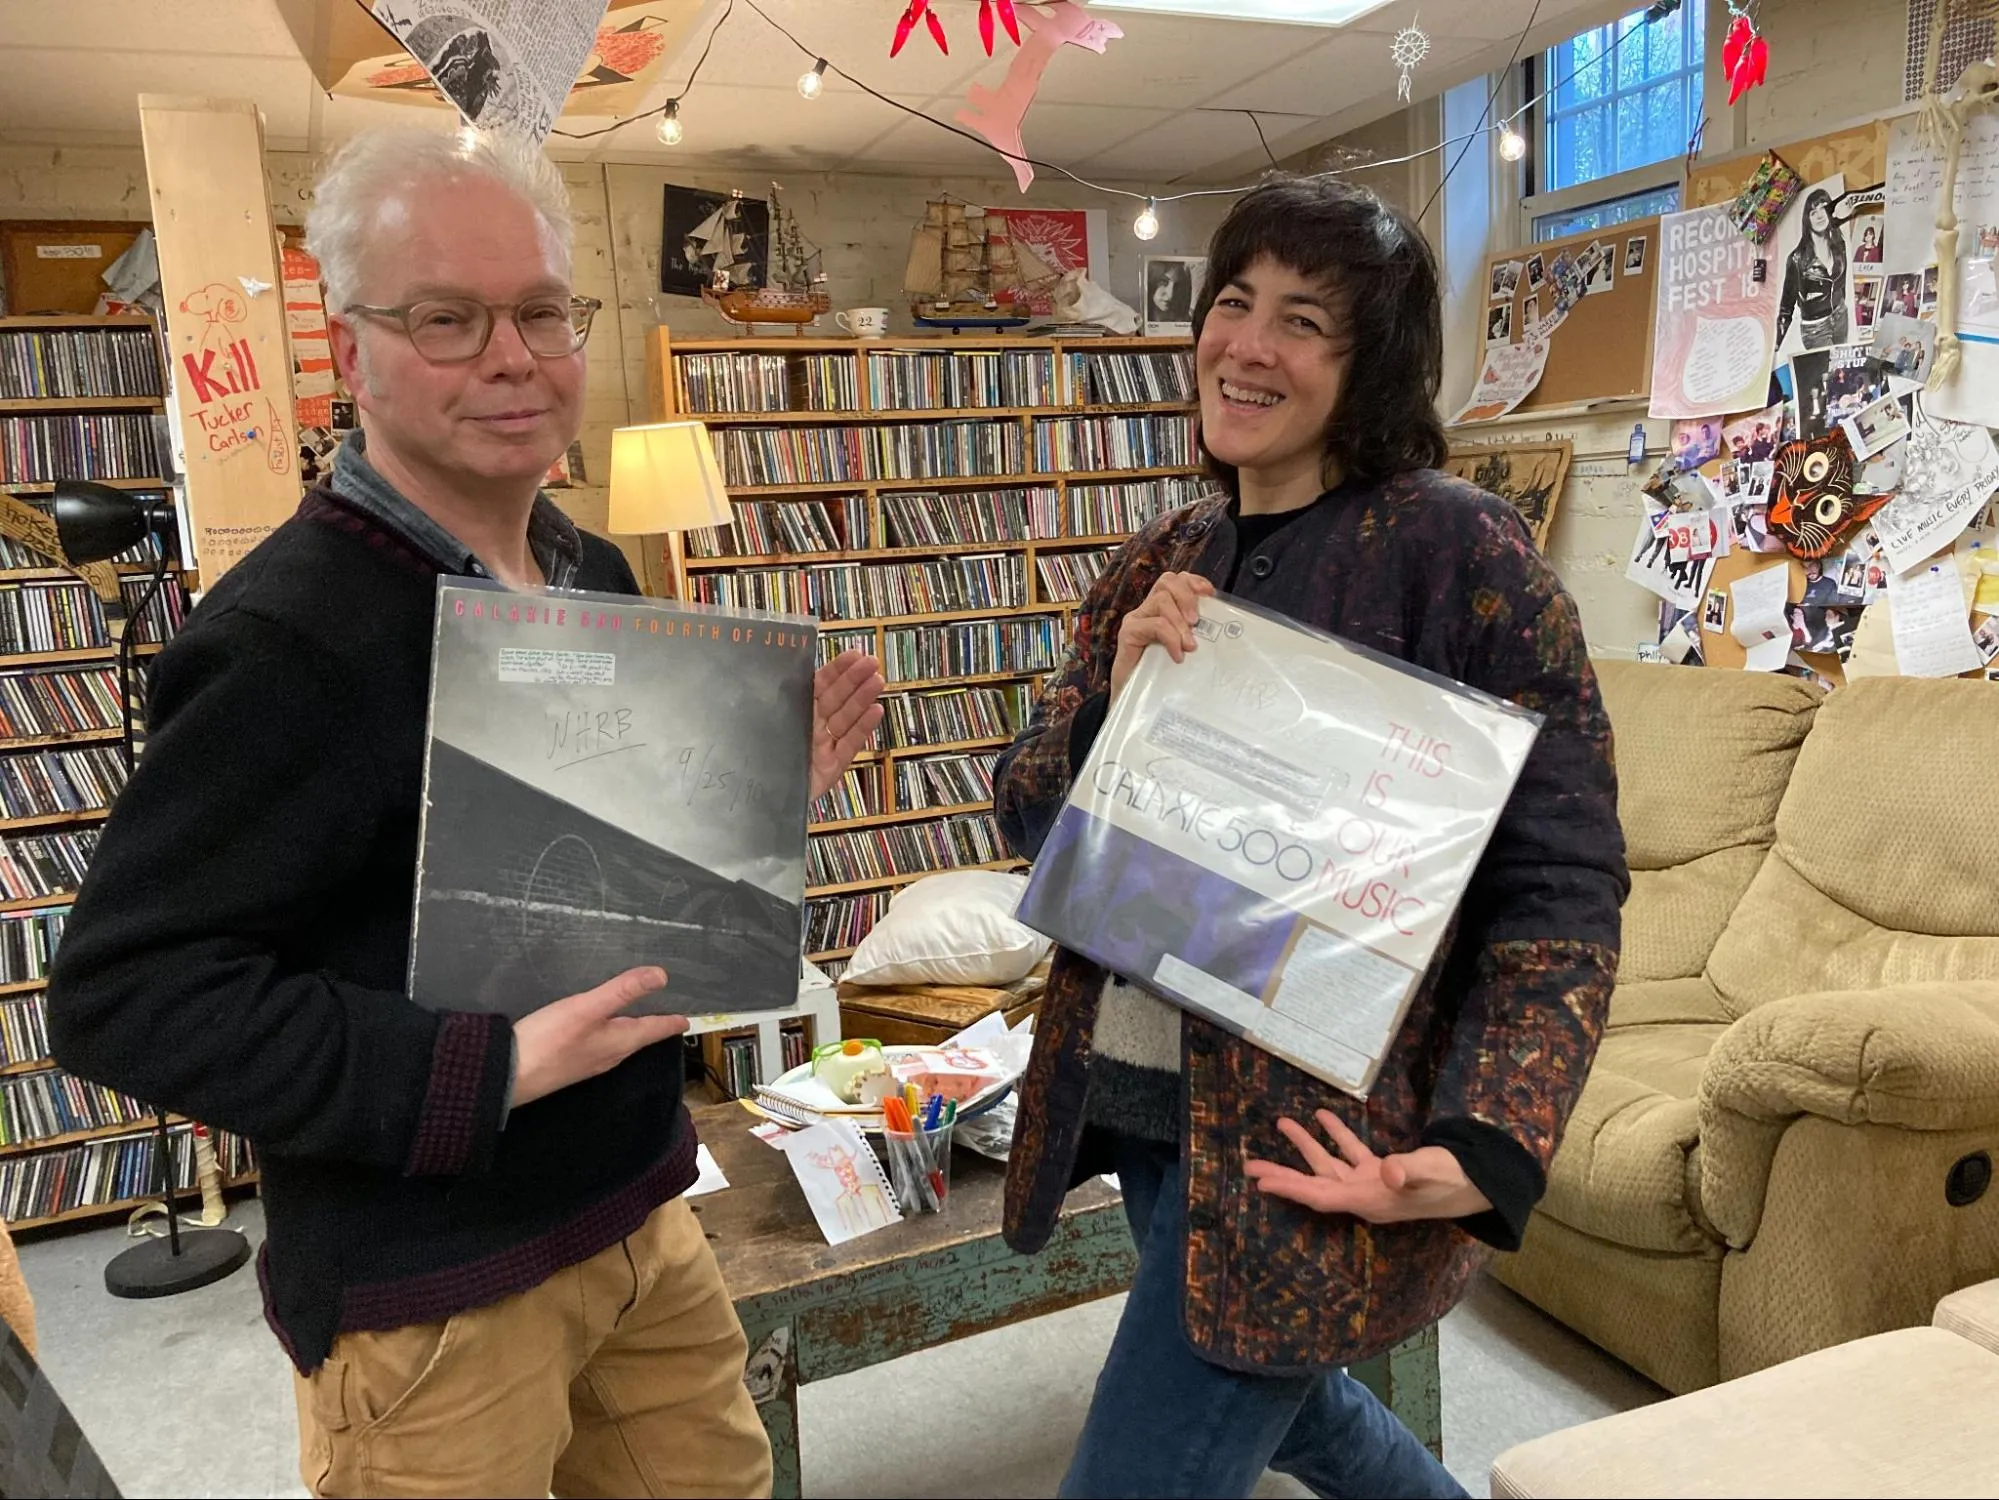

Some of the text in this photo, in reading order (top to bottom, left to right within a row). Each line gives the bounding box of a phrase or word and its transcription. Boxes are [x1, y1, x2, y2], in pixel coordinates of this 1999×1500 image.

[1669, 213, 1744, 252] RECOR
[1667, 277, 1727, 313] FEST
[857, 316, 872, 327] 22
[182, 338, 260, 404] Kill
[189, 401, 254, 432] Tucker
[208, 425, 265, 452] Carlsn
[1890, 529, 1914, 550] LIVE
[1917, 510, 1944, 534] MUSIC
[1945, 487, 1973, 512] EVERY
[455, 600, 567, 626] GALAXIE
[634, 618, 720, 640] FOURTH
[732, 627, 753, 642] OF
[765, 631, 808, 649] JULY
[1380, 721, 1452, 779] THIS
[1359, 769, 1394, 808] IS
[1217, 815, 1313, 882] 500
[1337, 817, 1417, 880] OUR
[1314, 857, 1425, 936] MUSIC
